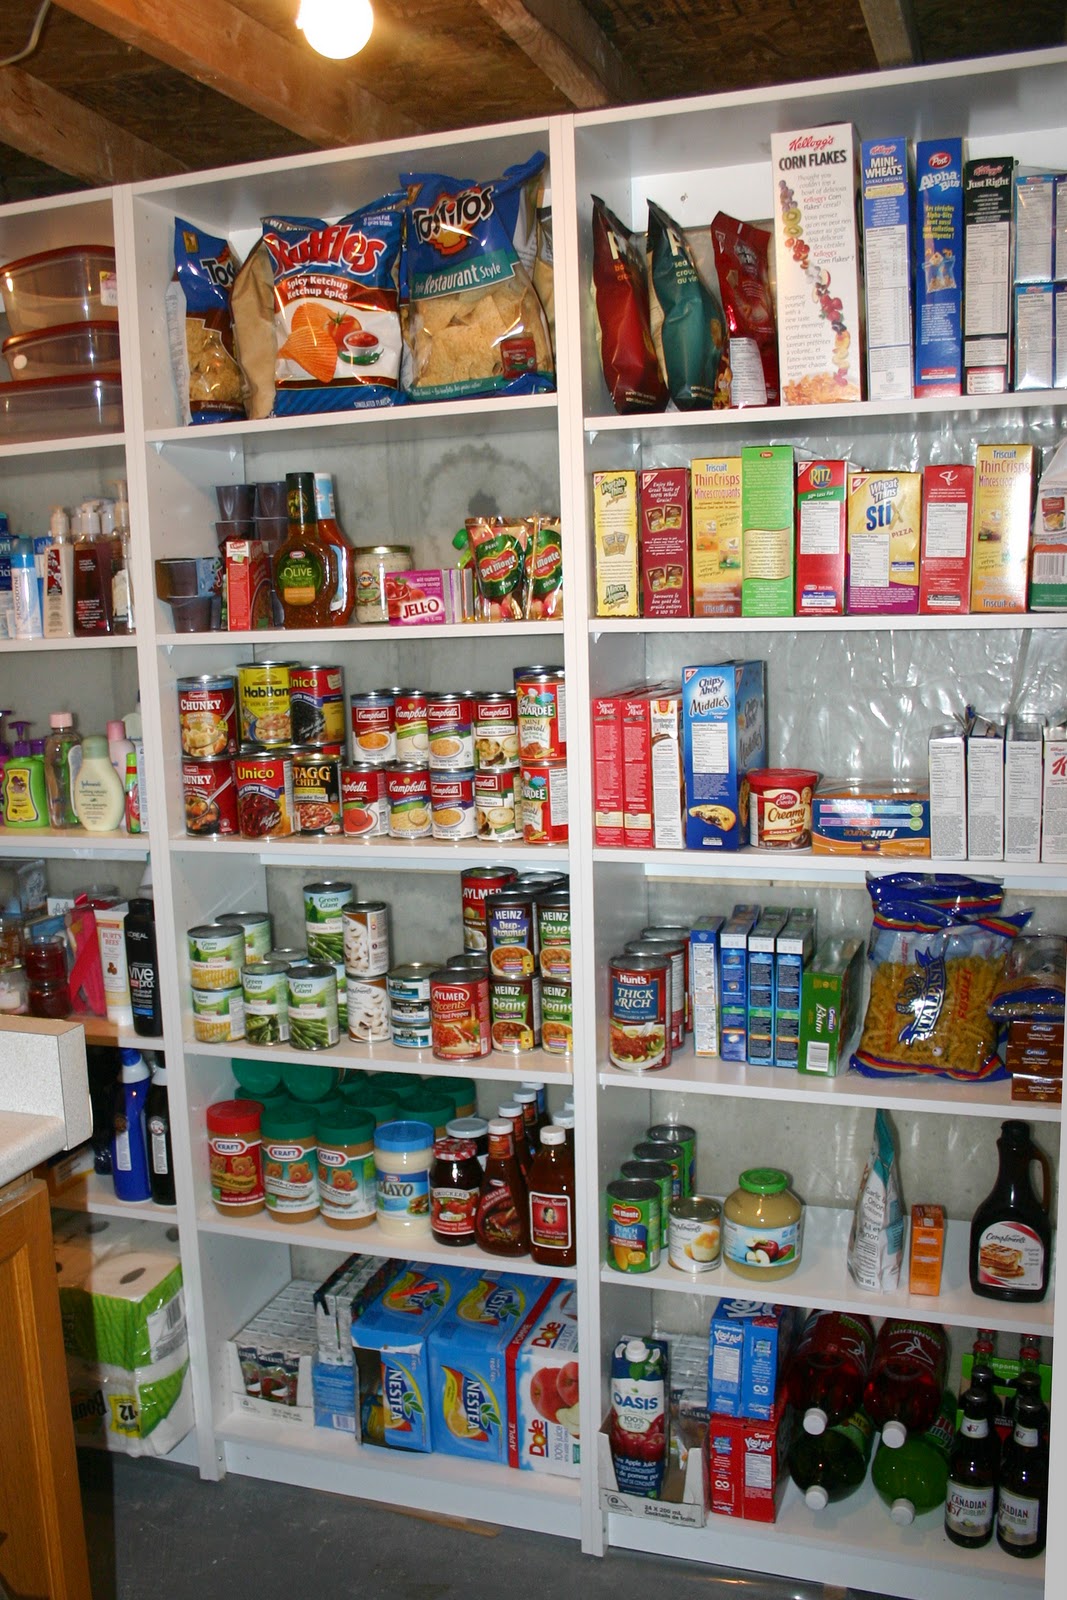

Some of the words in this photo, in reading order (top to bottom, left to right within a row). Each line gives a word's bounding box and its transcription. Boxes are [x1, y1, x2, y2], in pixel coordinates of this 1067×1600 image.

[789, 136, 834, 151] Kellogg's
[779, 155, 806, 171] CORN
[809, 149, 847, 168] FLAKES
[870, 157, 897, 168] MINI-
[931, 154, 948, 166] Post
[865, 165, 903, 178] WHEATS
[940, 180, 960, 191] Bits
[967, 180, 985, 190] Just
[986, 177, 1009, 188] Right
[263, 223, 388, 280] Ruffles
[287, 277, 307, 290] Spicy
[310, 275, 348, 290] Ketchup
[423, 264, 479, 295] Restaurant
[480, 263, 501, 279] Style
[287, 286, 322, 300] Ketchup
[324, 287, 348, 300] épicé
[993, 450, 1017, 459] Triscuit
[706, 463, 727, 472] Triscuit
[695, 474, 740, 487] ThinCrisps
[810, 467, 832, 485] RITZ
[978, 475, 999, 487] Minces
[870, 477, 899, 496] Wheat
[694, 487, 713, 499] Minces
[891, 527, 913, 538] PIZZA
[537, 551, 561, 568] Monte
[481, 566, 492, 577] Del
[492, 555, 517, 570] Monte
[284, 567, 312, 579] OLIVE
[699, 677, 721, 688] Chips
[244, 686, 289, 698] Habitan
[181, 700, 222, 711] CHUNKY
[689, 695, 730, 717] Middles
[522, 725, 546, 733] Ravioli
[237, 767, 275, 779] Unico
[293, 766, 331, 781] TAGG
[296, 778, 320, 786] CHILI
[779, 794, 793, 802] Betty
[768, 808, 806, 823] Creamy
[495, 910, 522, 920] HEINZ
[542, 911, 568, 921] HEINZ
[102, 932, 122, 940] BURT'S
[619, 974, 647, 985] Hunt's
[435, 990, 464, 1001] AYLMER
[494, 986, 521, 996] HEINZ
[543, 986, 567, 997] HEINZ
[617, 987, 654, 999] THICK
[492, 1000, 526, 1011] Beans
[541, 1000, 572, 1013] Beans
[619, 998, 651, 1009] RICH
[451, 1011, 469, 1020] Pepper
[320, 1153, 339, 1162] KRAFT
[378, 1181, 413, 1197] MAYO
[620, 1209, 638, 1218] Monte
[986, 1232, 1026, 1243] Compliments
[481, 1288, 514, 1318] NESTEA
[531, 1321, 562, 1349] Dole
[713, 1330, 742, 1344] Kool-Aid
[388, 1369, 402, 1421] NESTEA
[613, 1391, 659, 1410] OASIS
[467, 1380, 481, 1430] NESTEA
[119, 1404, 136, 1421] 12
[624, 1415, 645, 1425] 100%
[529, 1419, 546, 1457] Dole
[554, 1425, 563, 1441] juice
[744, 1437, 773, 1451] Kool-Aid
[554, 1441, 563, 1461] 100%
[625, 1458, 641, 1466] Apple
[627, 1472, 648, 1481] pomme
[952, 1494, 987, 1509] CANADIAN
